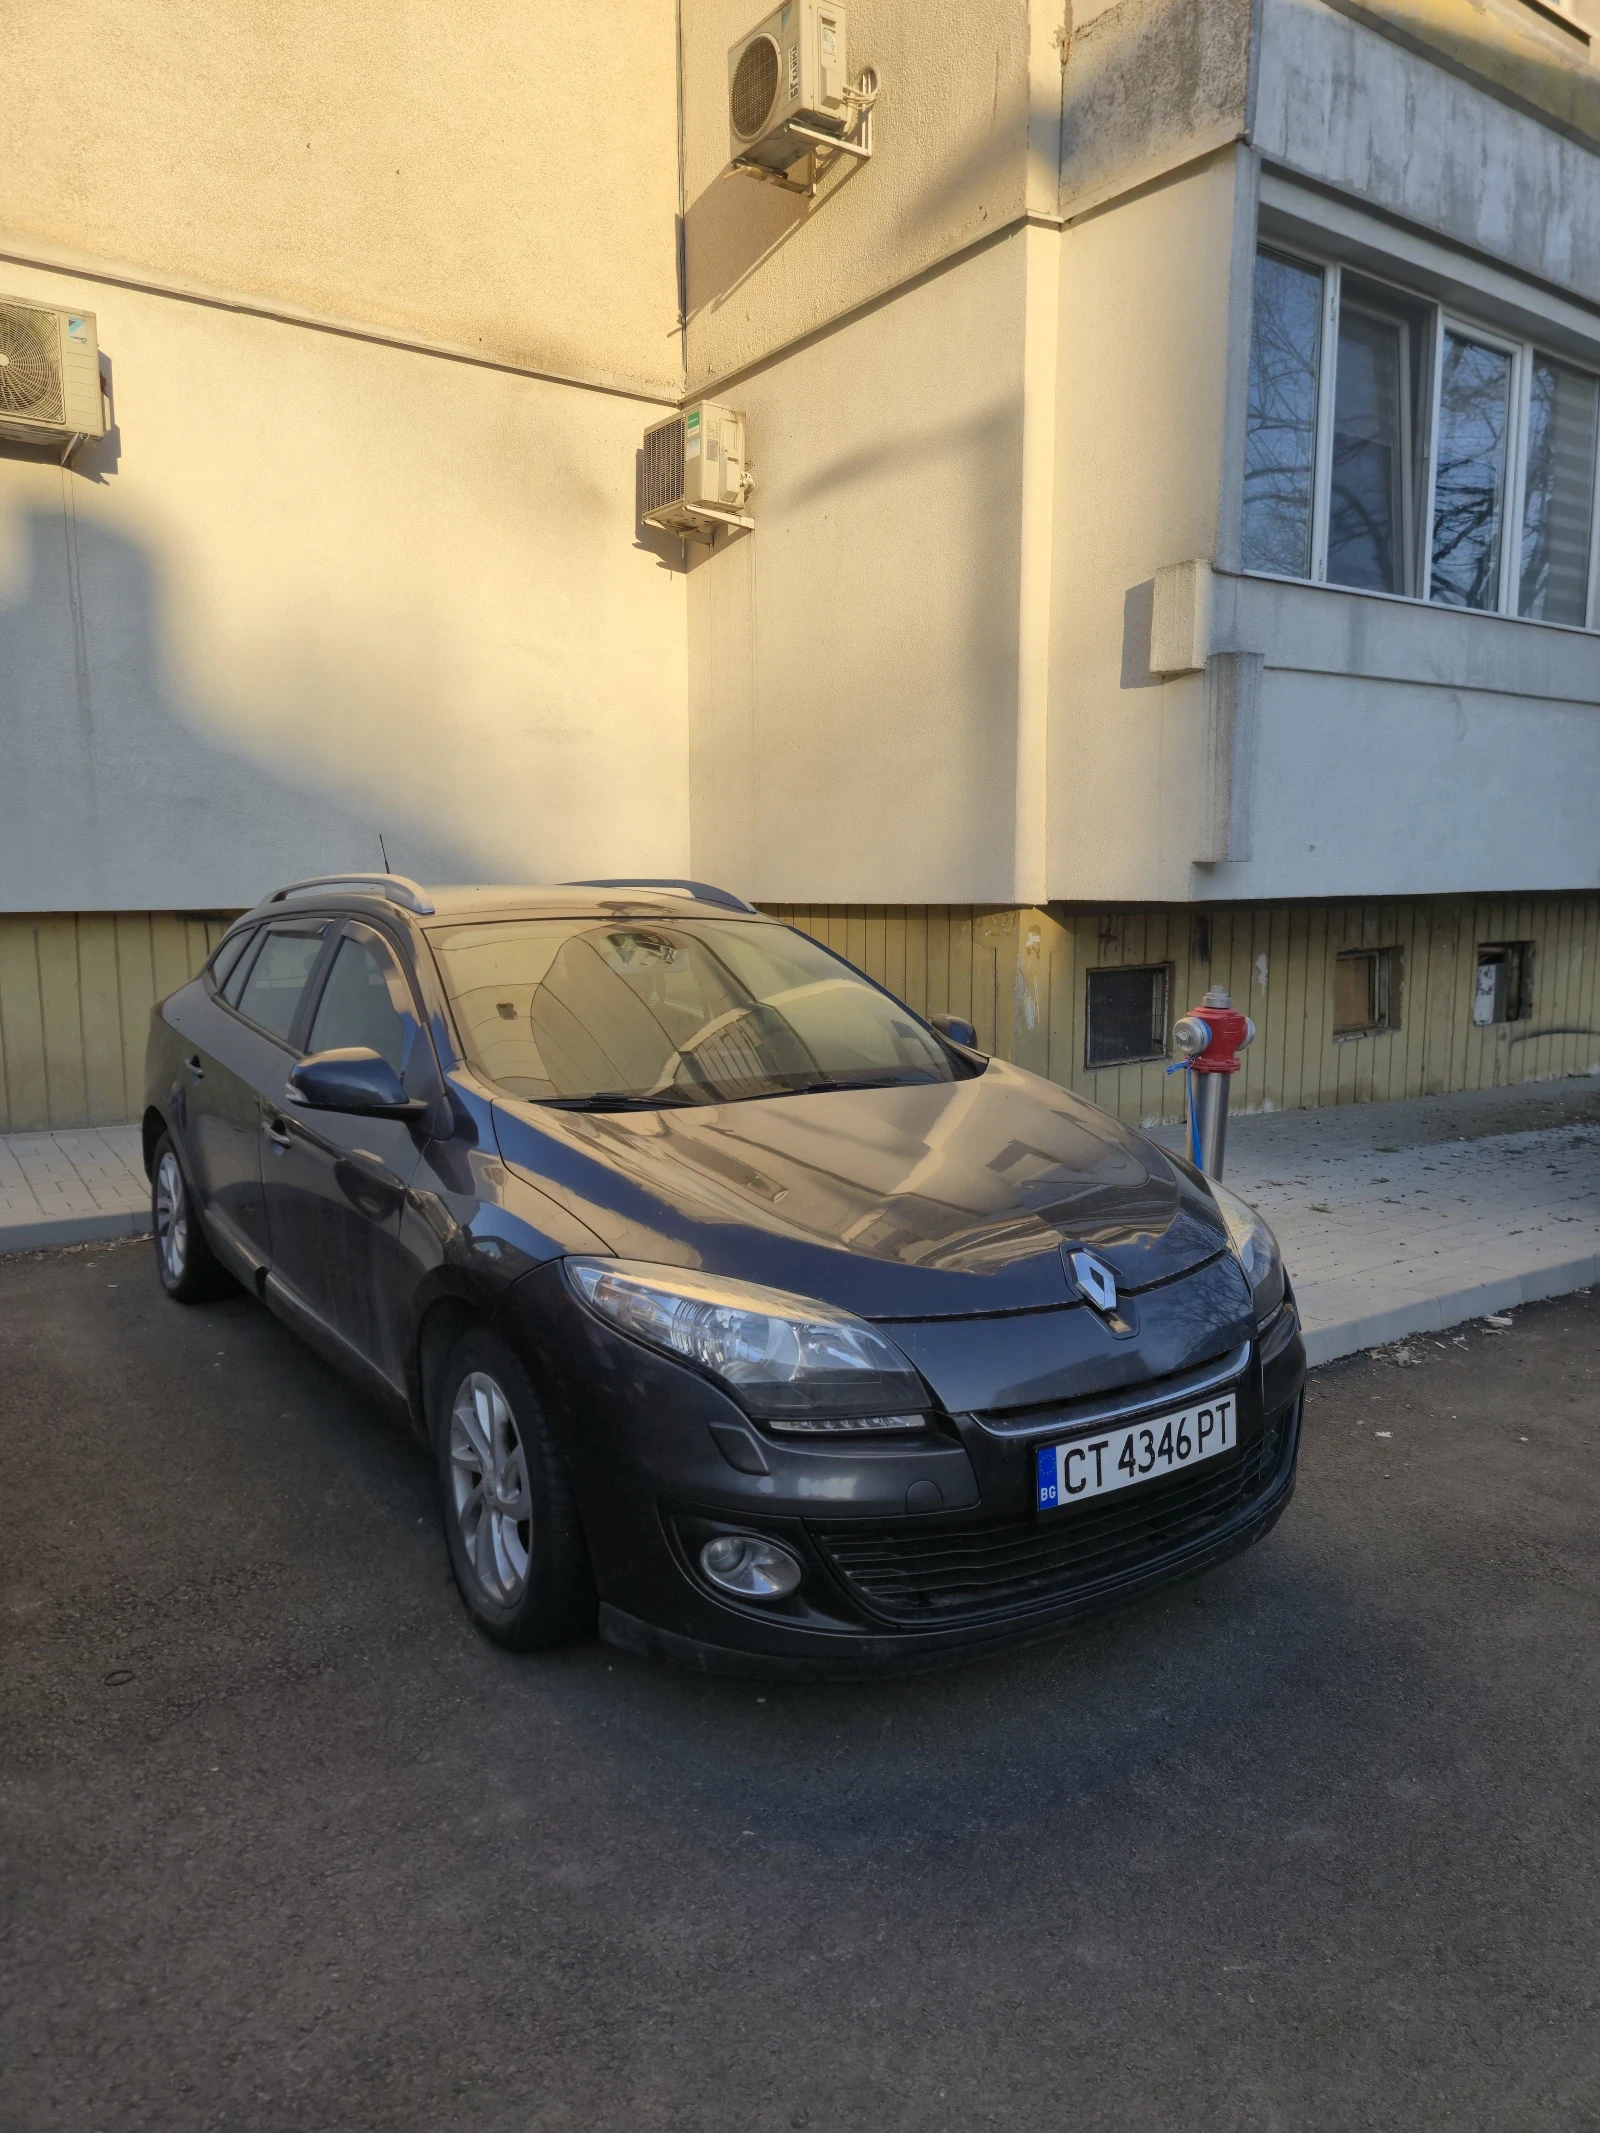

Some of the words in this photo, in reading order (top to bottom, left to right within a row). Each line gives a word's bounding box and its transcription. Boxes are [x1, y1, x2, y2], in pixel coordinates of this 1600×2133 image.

[1064, 1440, 1109, 1494] CT
[1118, 1417, 1192, 1478] 4346
[1197, 1401, 1231, 1453] PT
[1041, 1485, 1056, 1501] BG
